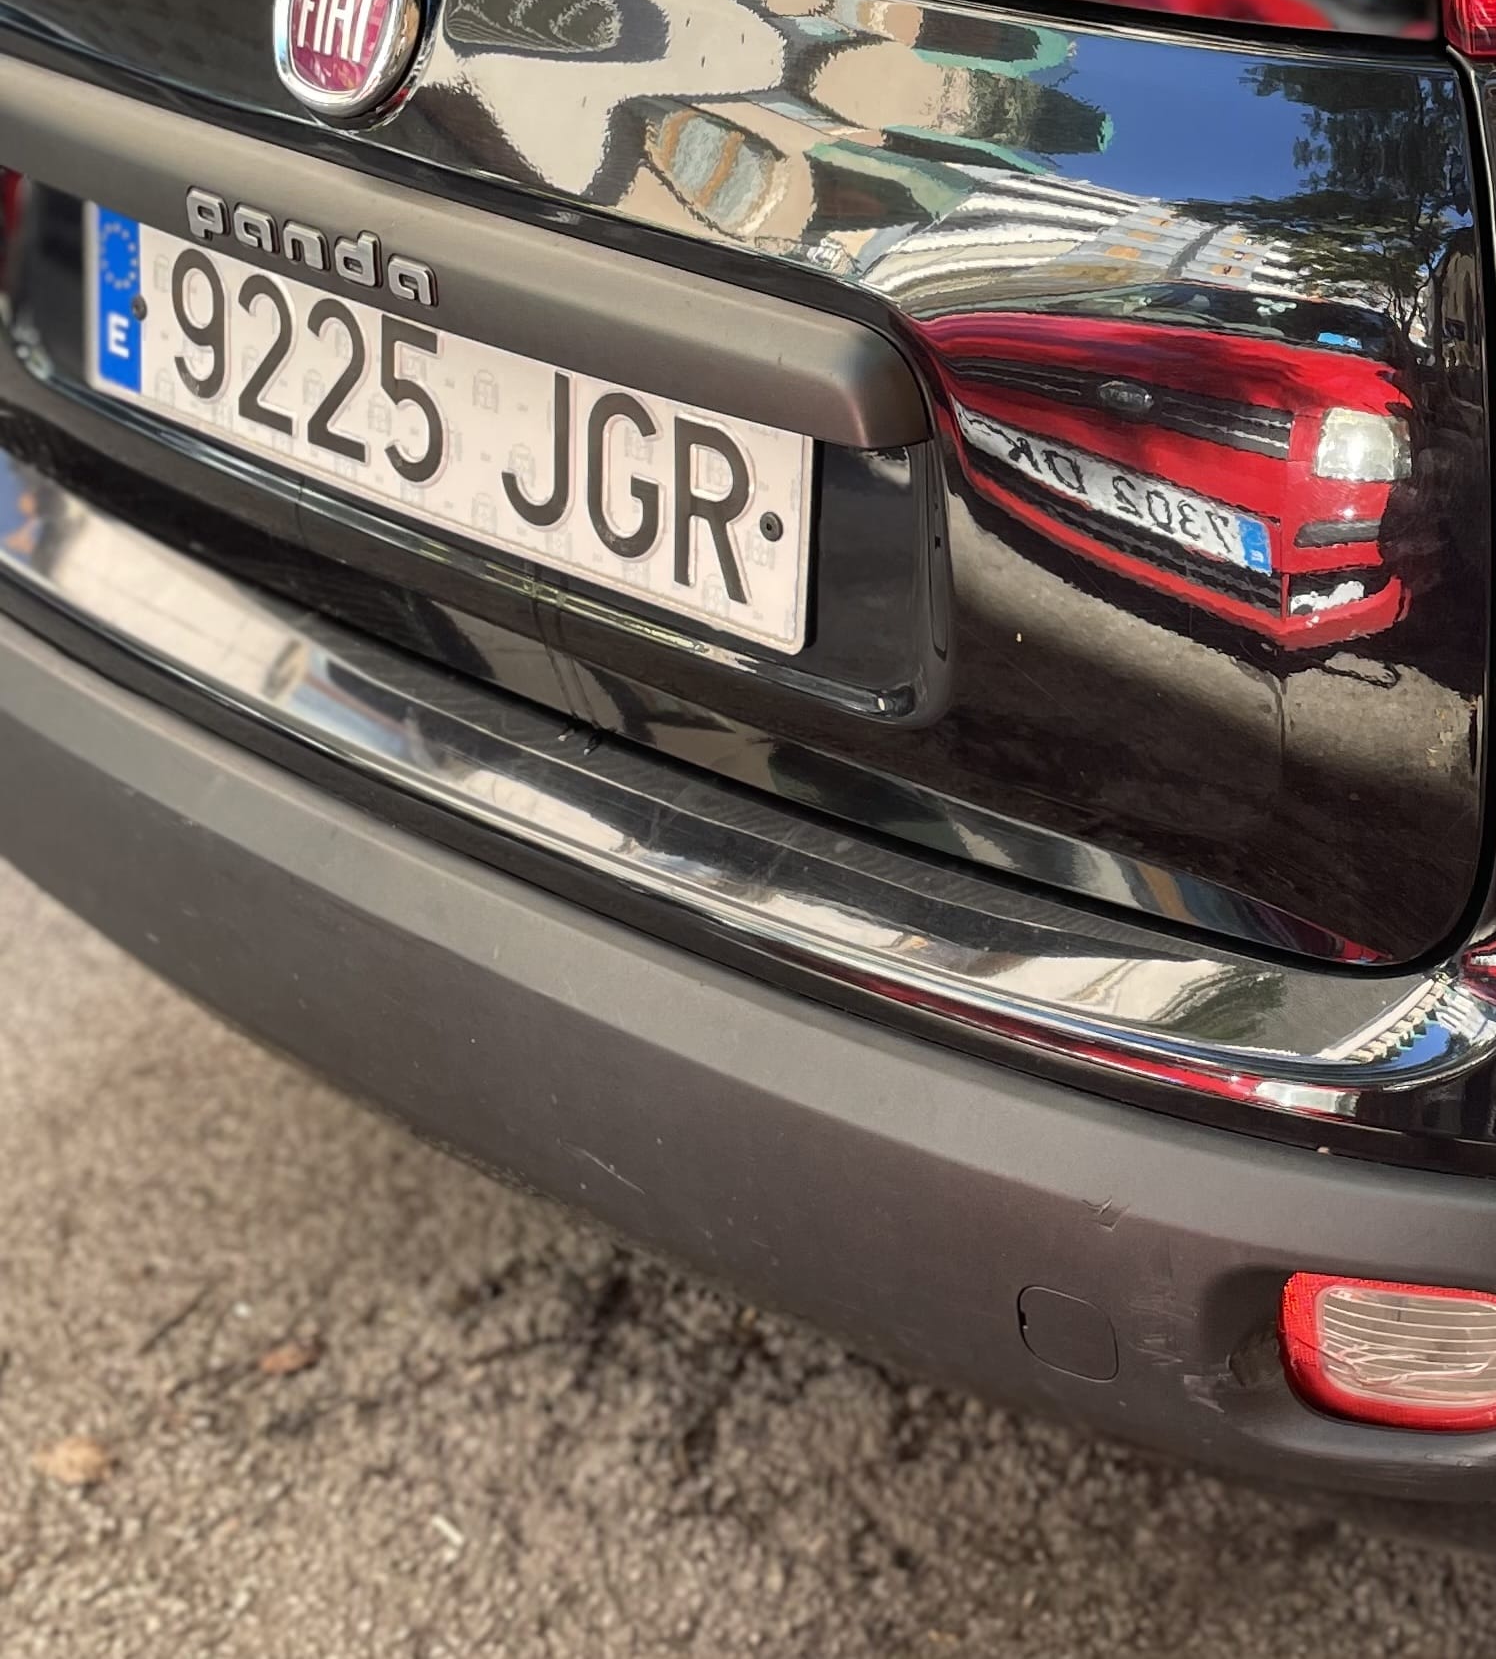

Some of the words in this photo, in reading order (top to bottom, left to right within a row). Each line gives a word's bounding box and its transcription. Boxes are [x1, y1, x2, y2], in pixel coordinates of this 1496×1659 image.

[185, 185, 438, 307] panda
[106, 310, 130, 359] E
[170, 248, 446, 484] 9225
[501, 371, 756, 605] JGR
